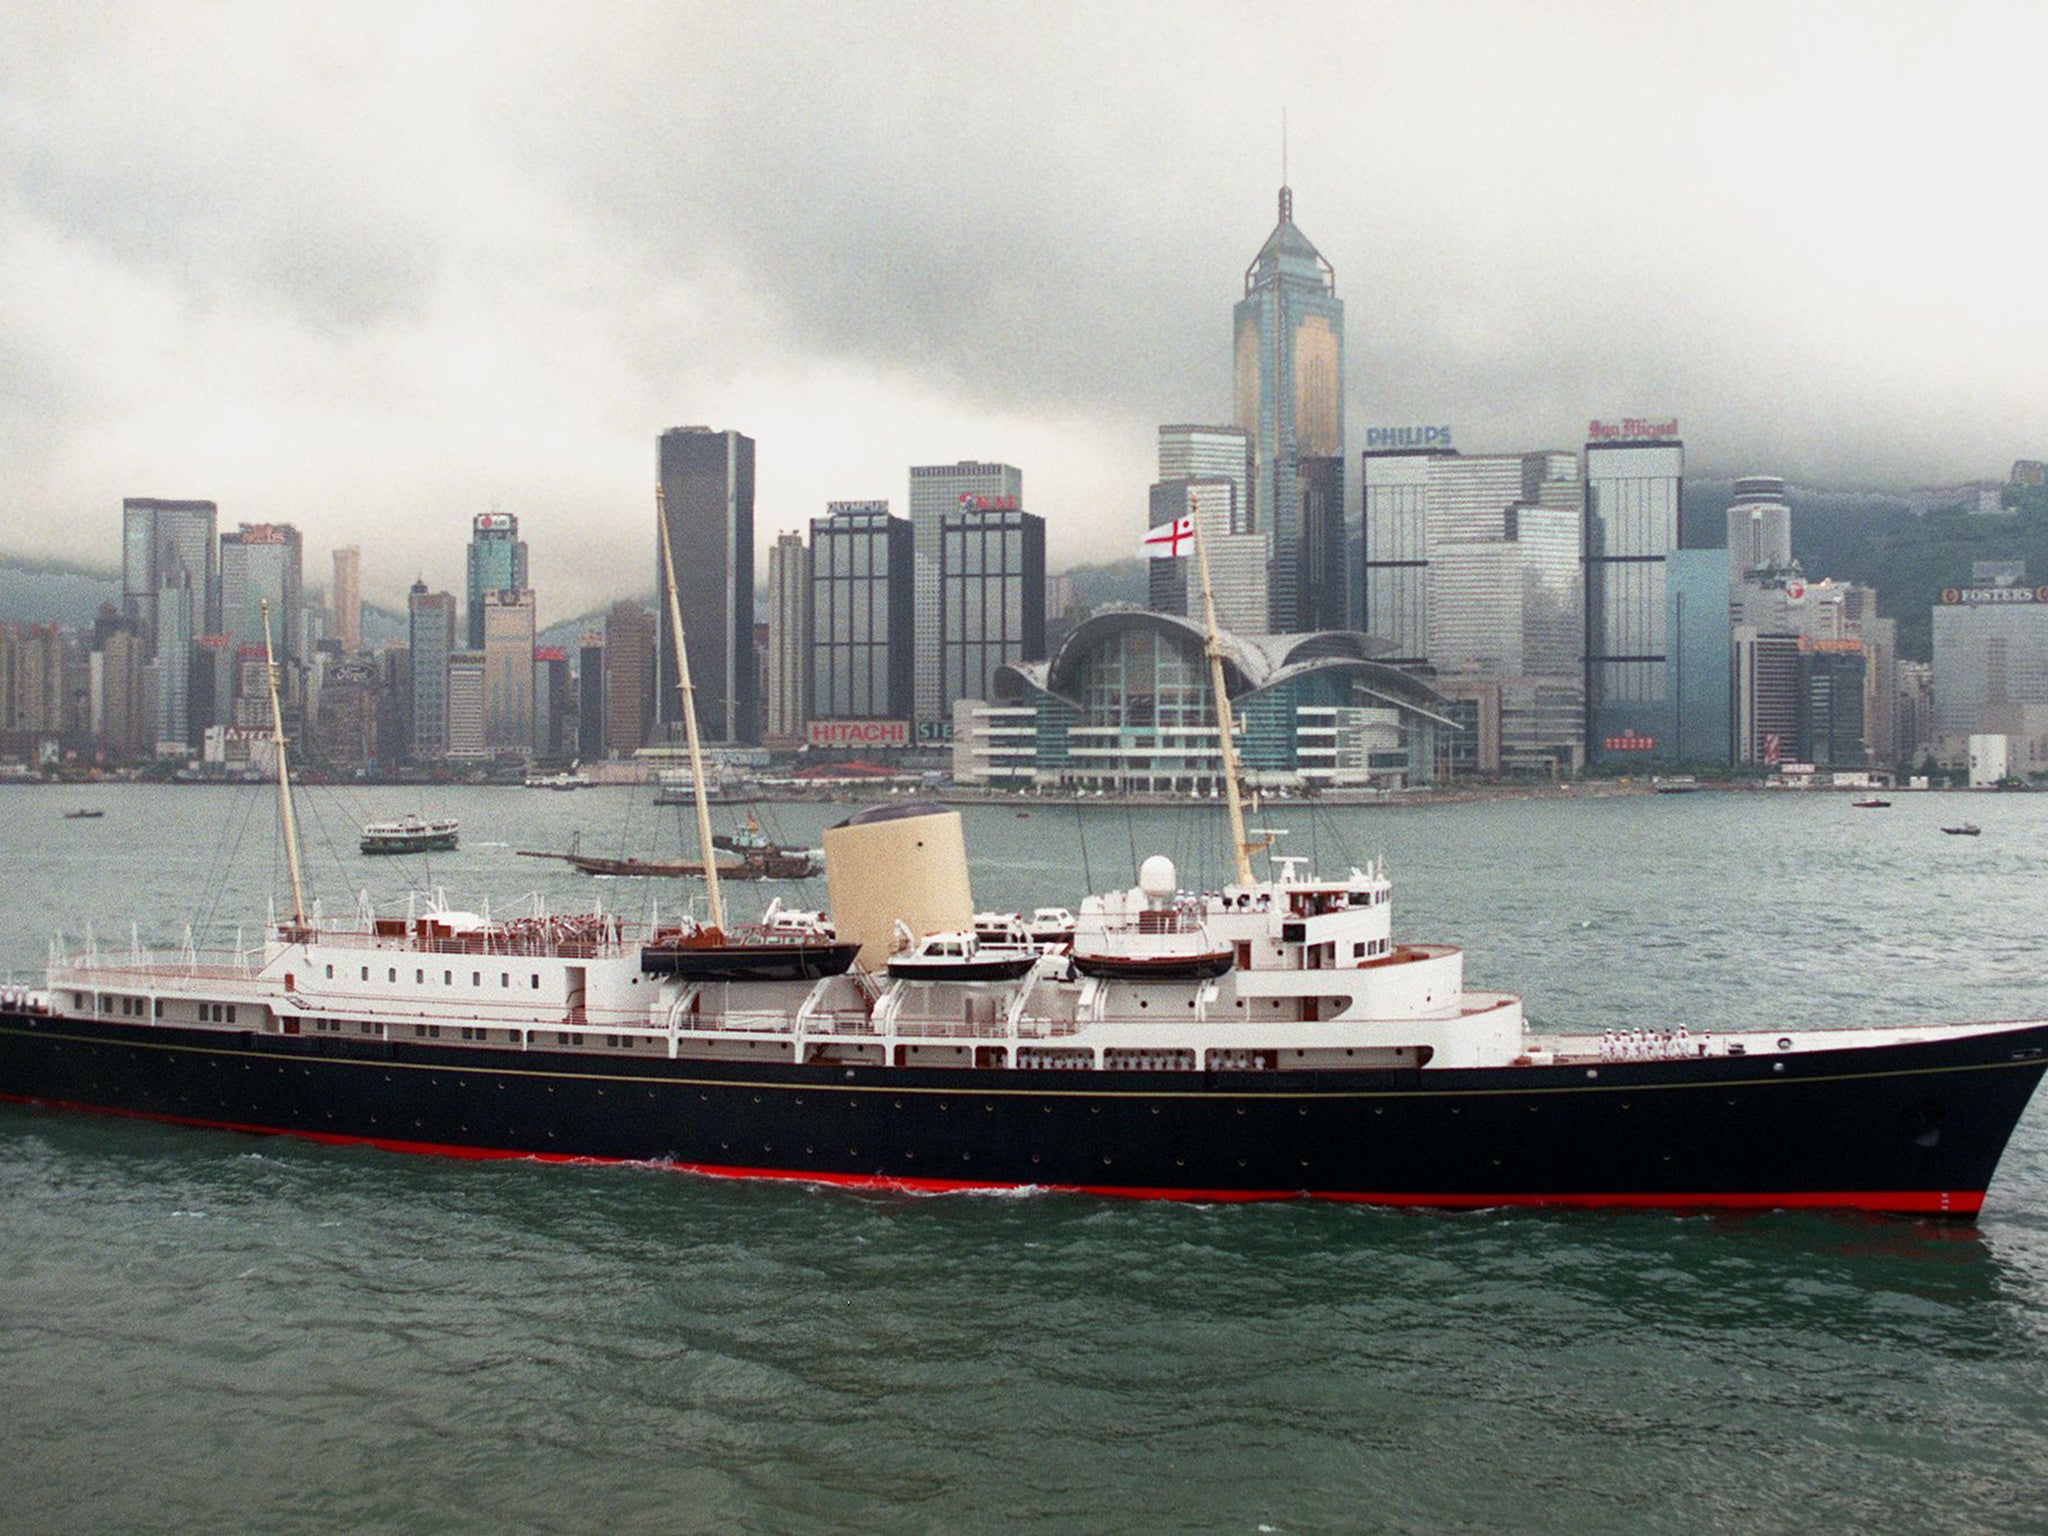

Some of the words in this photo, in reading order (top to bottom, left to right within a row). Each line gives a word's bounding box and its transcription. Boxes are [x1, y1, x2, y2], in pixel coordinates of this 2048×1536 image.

[1366, 427, 1451, 446] PHILIPS
[1588, 419, 1618, 439] San
[1622, 418, 1678, 438] Miguel
[812, 723, 904, 742] HITACHI
